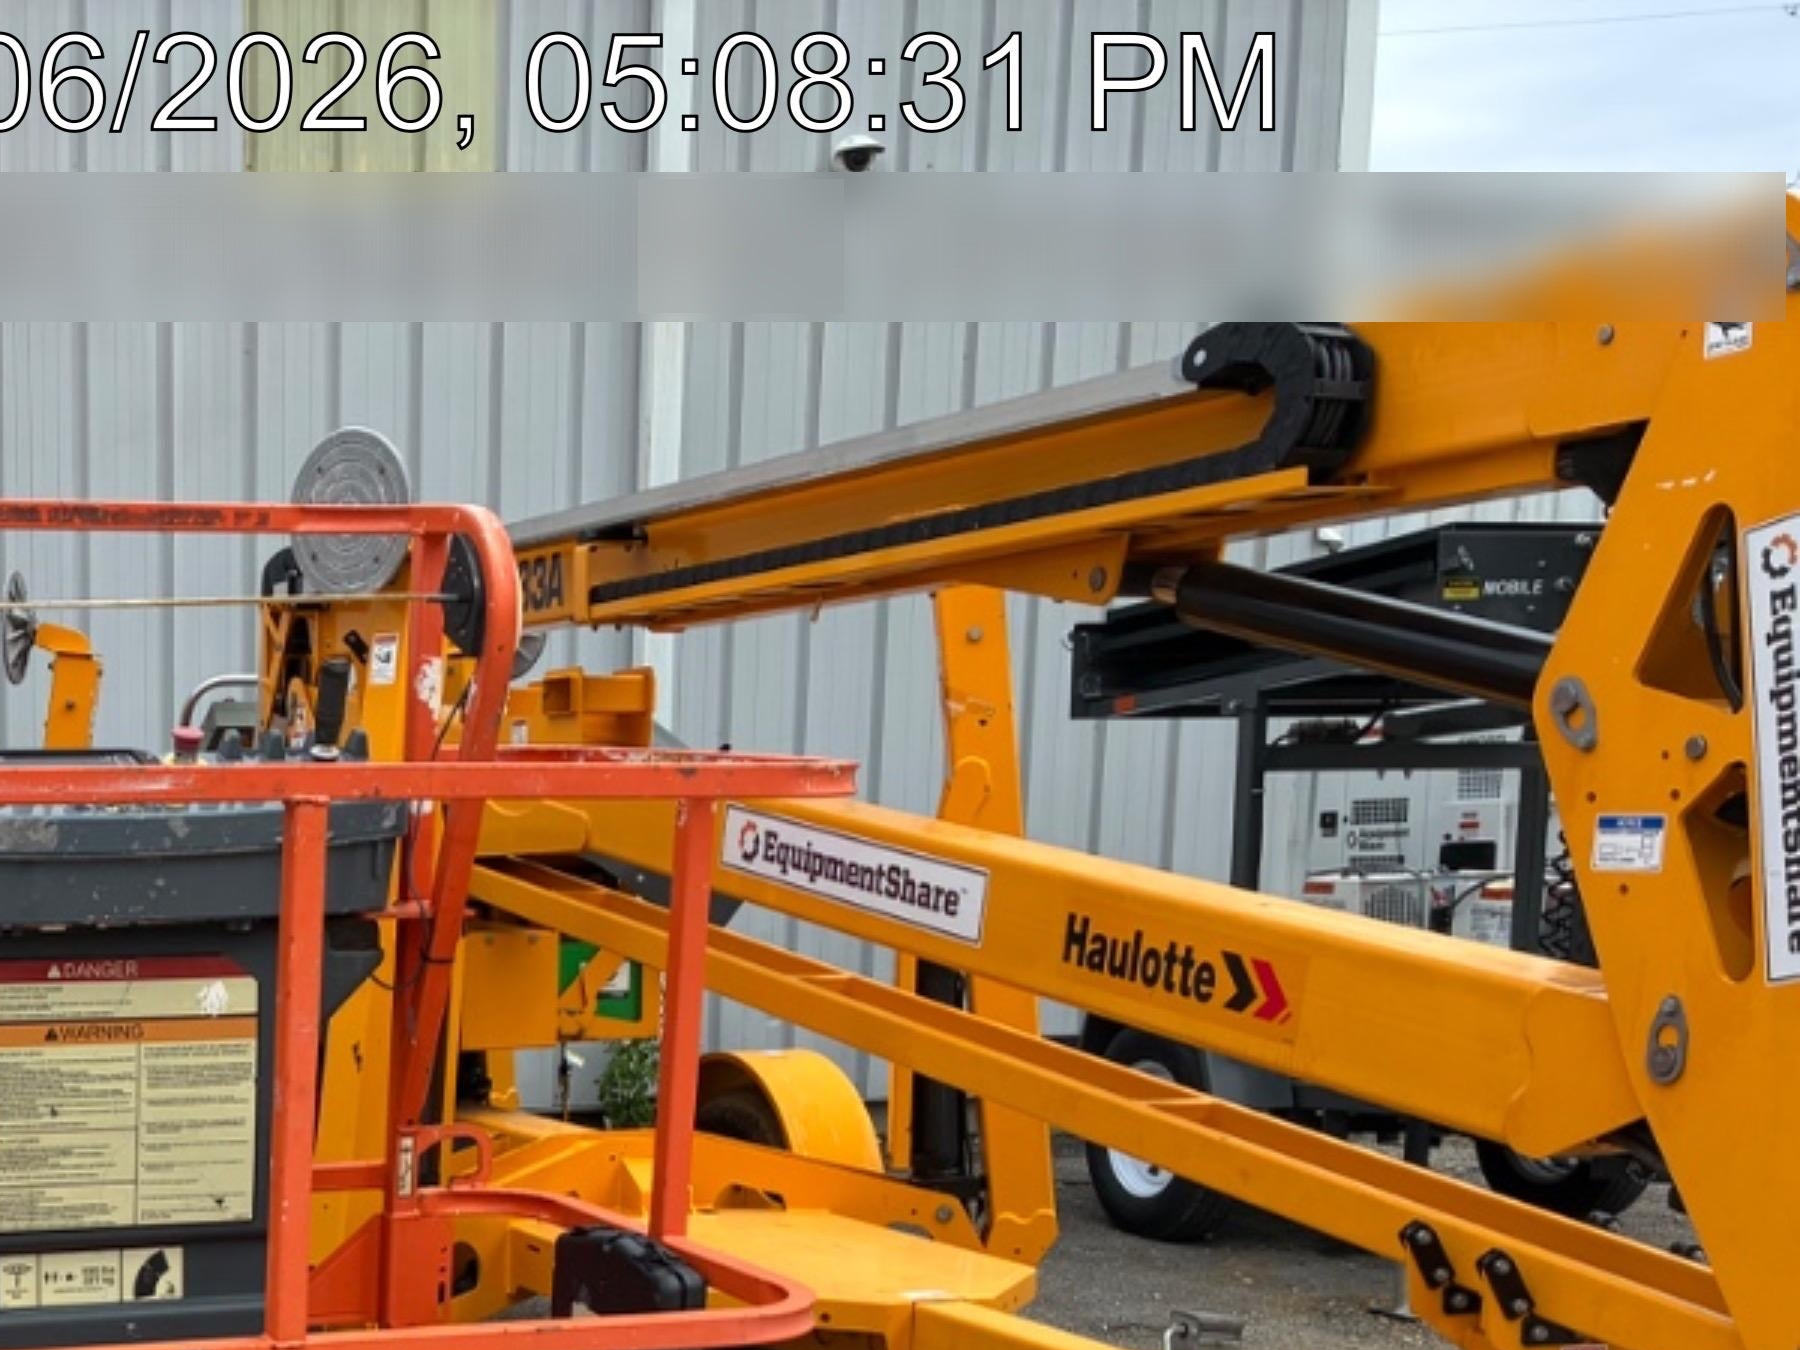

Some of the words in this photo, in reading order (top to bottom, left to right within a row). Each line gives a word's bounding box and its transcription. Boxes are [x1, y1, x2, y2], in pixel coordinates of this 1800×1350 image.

[1484, 578, 1544, 596] MOBILE
[761, 829, 961, 916] EquipmentShare
[1062, 911, 1216, 1004] Haulotte
[62, 960, 139, 979] DANGER
[59, 1023, 145, 1042] WARNING
